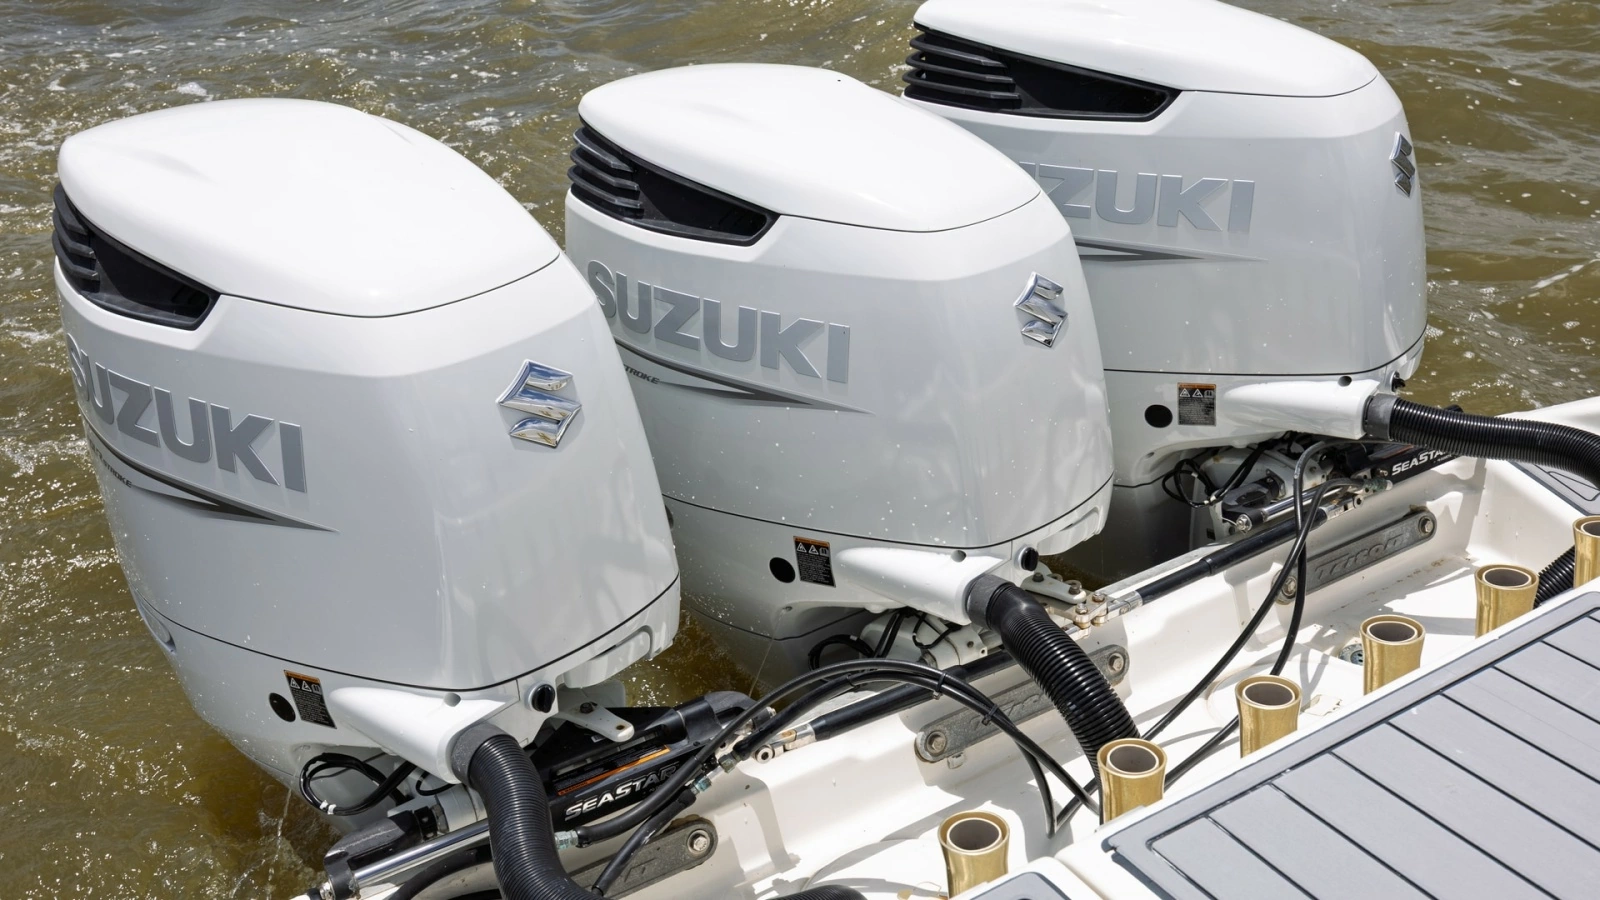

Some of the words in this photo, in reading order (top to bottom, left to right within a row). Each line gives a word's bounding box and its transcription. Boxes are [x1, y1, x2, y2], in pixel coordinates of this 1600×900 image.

[1019, 161, 1256, 232] ZUKI
[588, 260, 851, 384] SUZUKI
[623, 363, 661, 385] TROKE
[66, 332, 308, 493] SUZUKI
[1391, 449, 1447, 476] SEASTA
